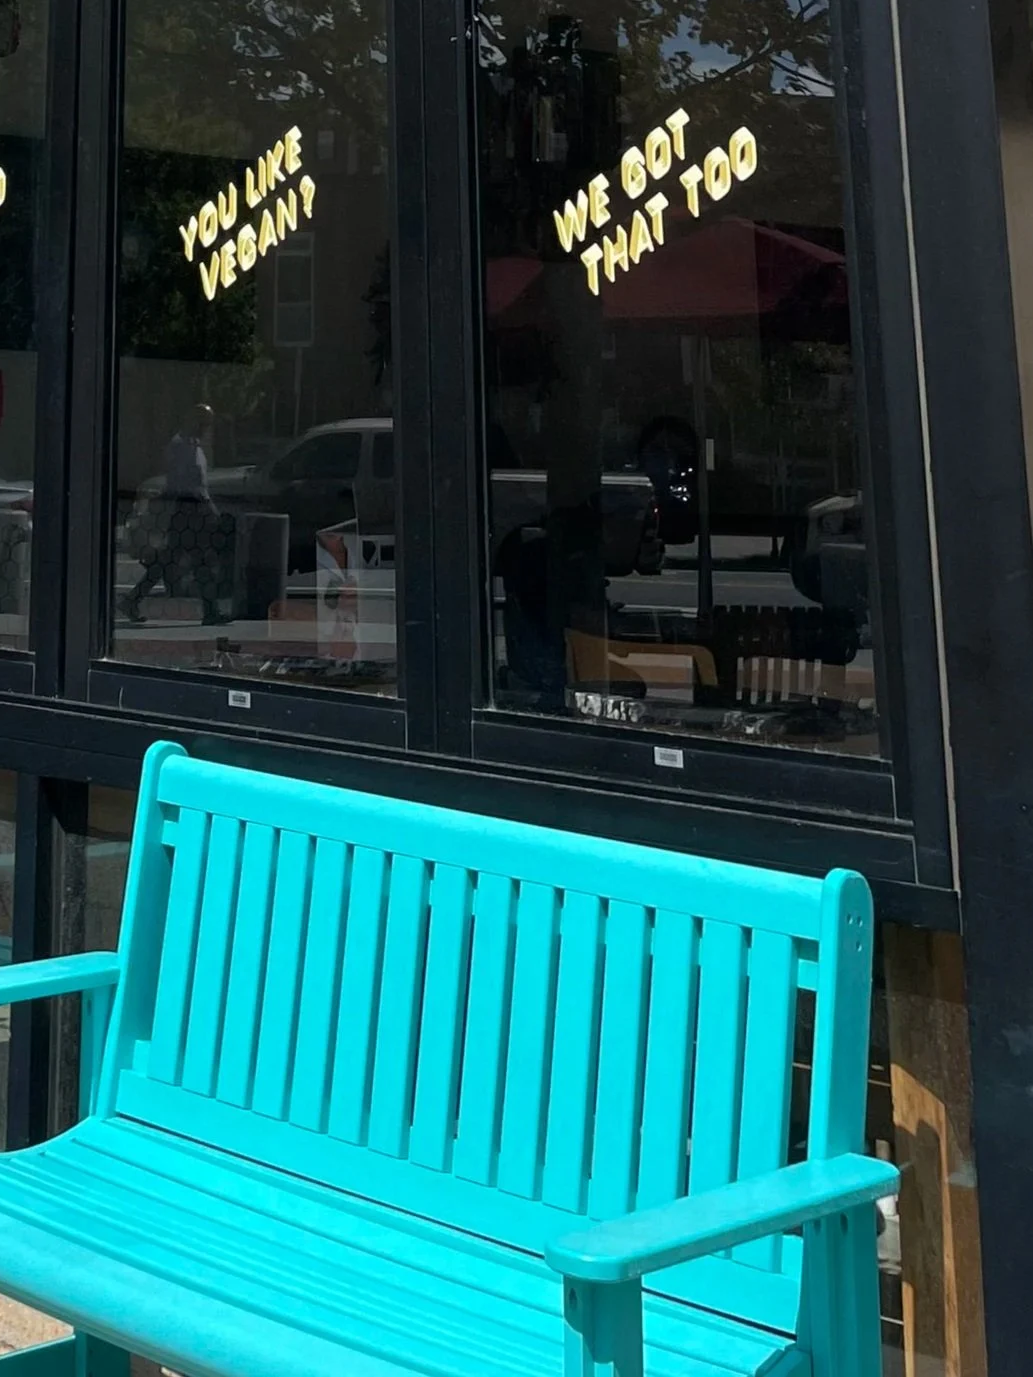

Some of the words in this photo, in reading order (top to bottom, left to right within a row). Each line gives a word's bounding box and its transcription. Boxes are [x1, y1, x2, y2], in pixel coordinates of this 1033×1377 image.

[179, 182, 237, 262] YOU
[246, 125, 302, 209] LIKE
[199, 175, 316, 301] VEGAN?
[552, 173, 611, 253] WE
[621, 107, 690, 200] GOT
[580, 191, 669, 296] THAT
[679, 126, 757, 218] TOO
